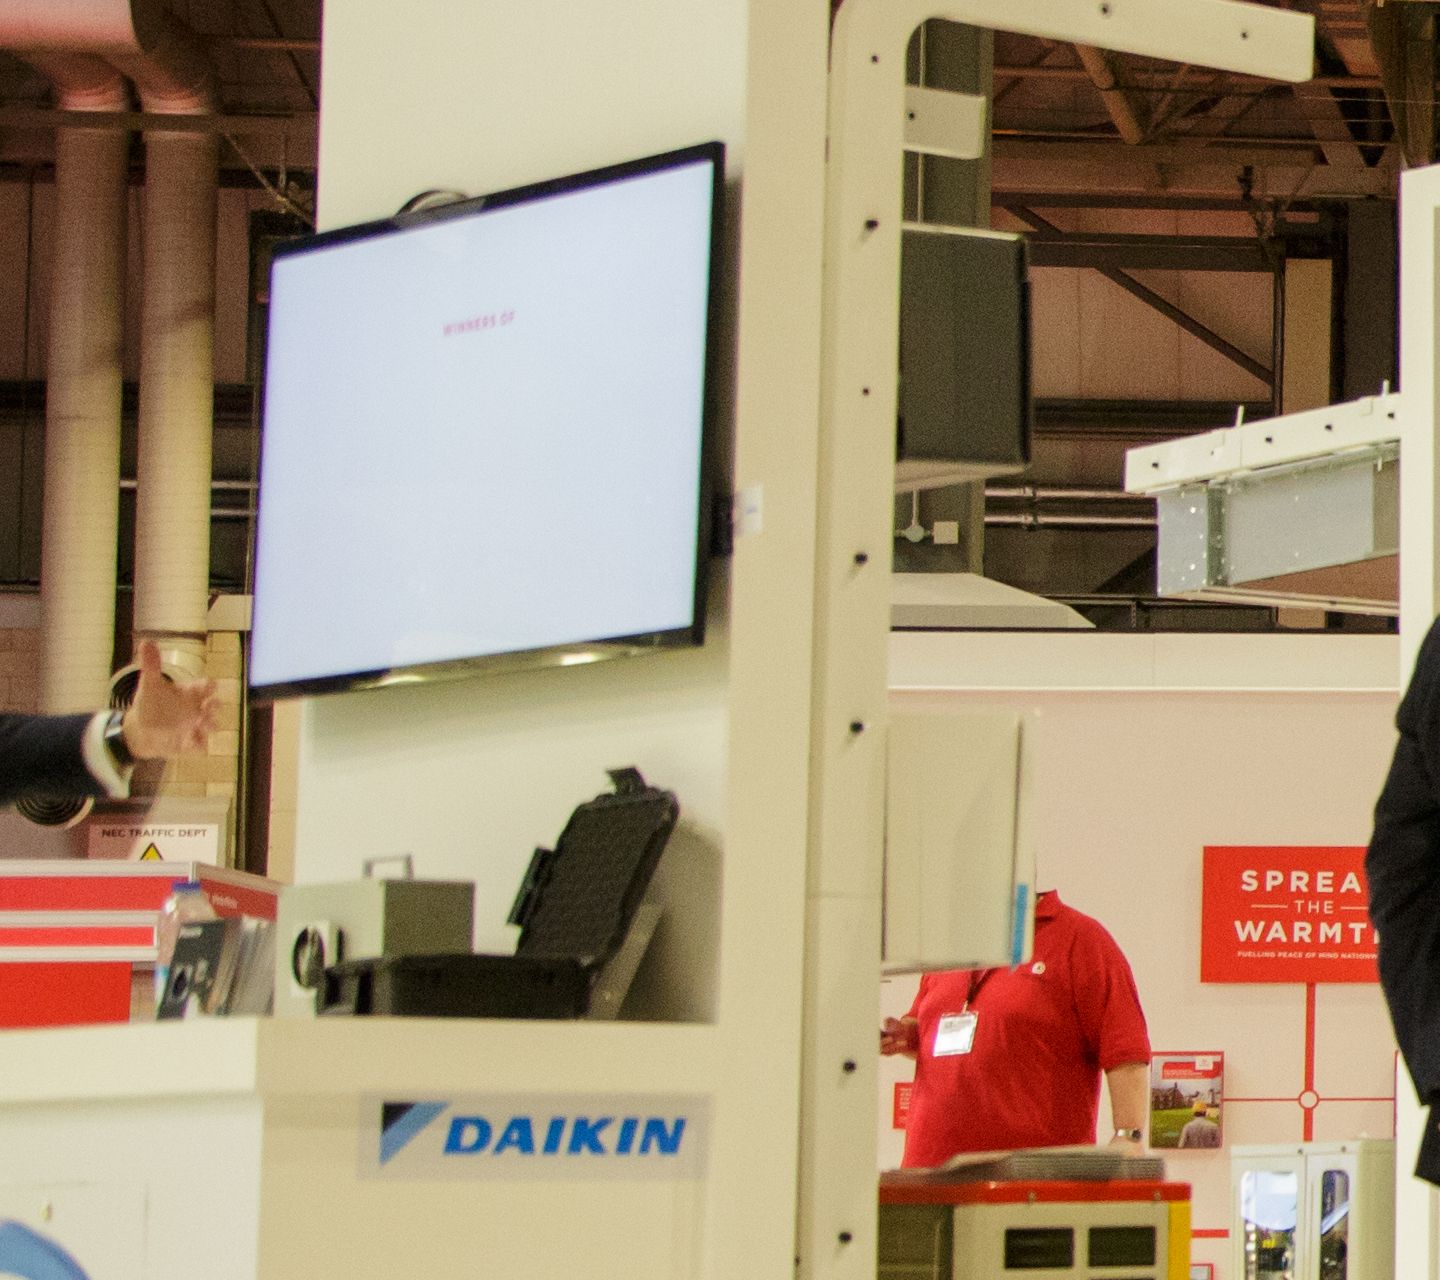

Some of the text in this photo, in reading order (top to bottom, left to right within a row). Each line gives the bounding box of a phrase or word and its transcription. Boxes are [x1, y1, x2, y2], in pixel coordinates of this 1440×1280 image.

[102, 829, 208, 838] NEC TRAFFIC DEPT
[1241, 870, 1362, 894] SPREA
[1294, 900, 1335, 915] THE
[443, 1115, 688, 1156] DAIKIN
